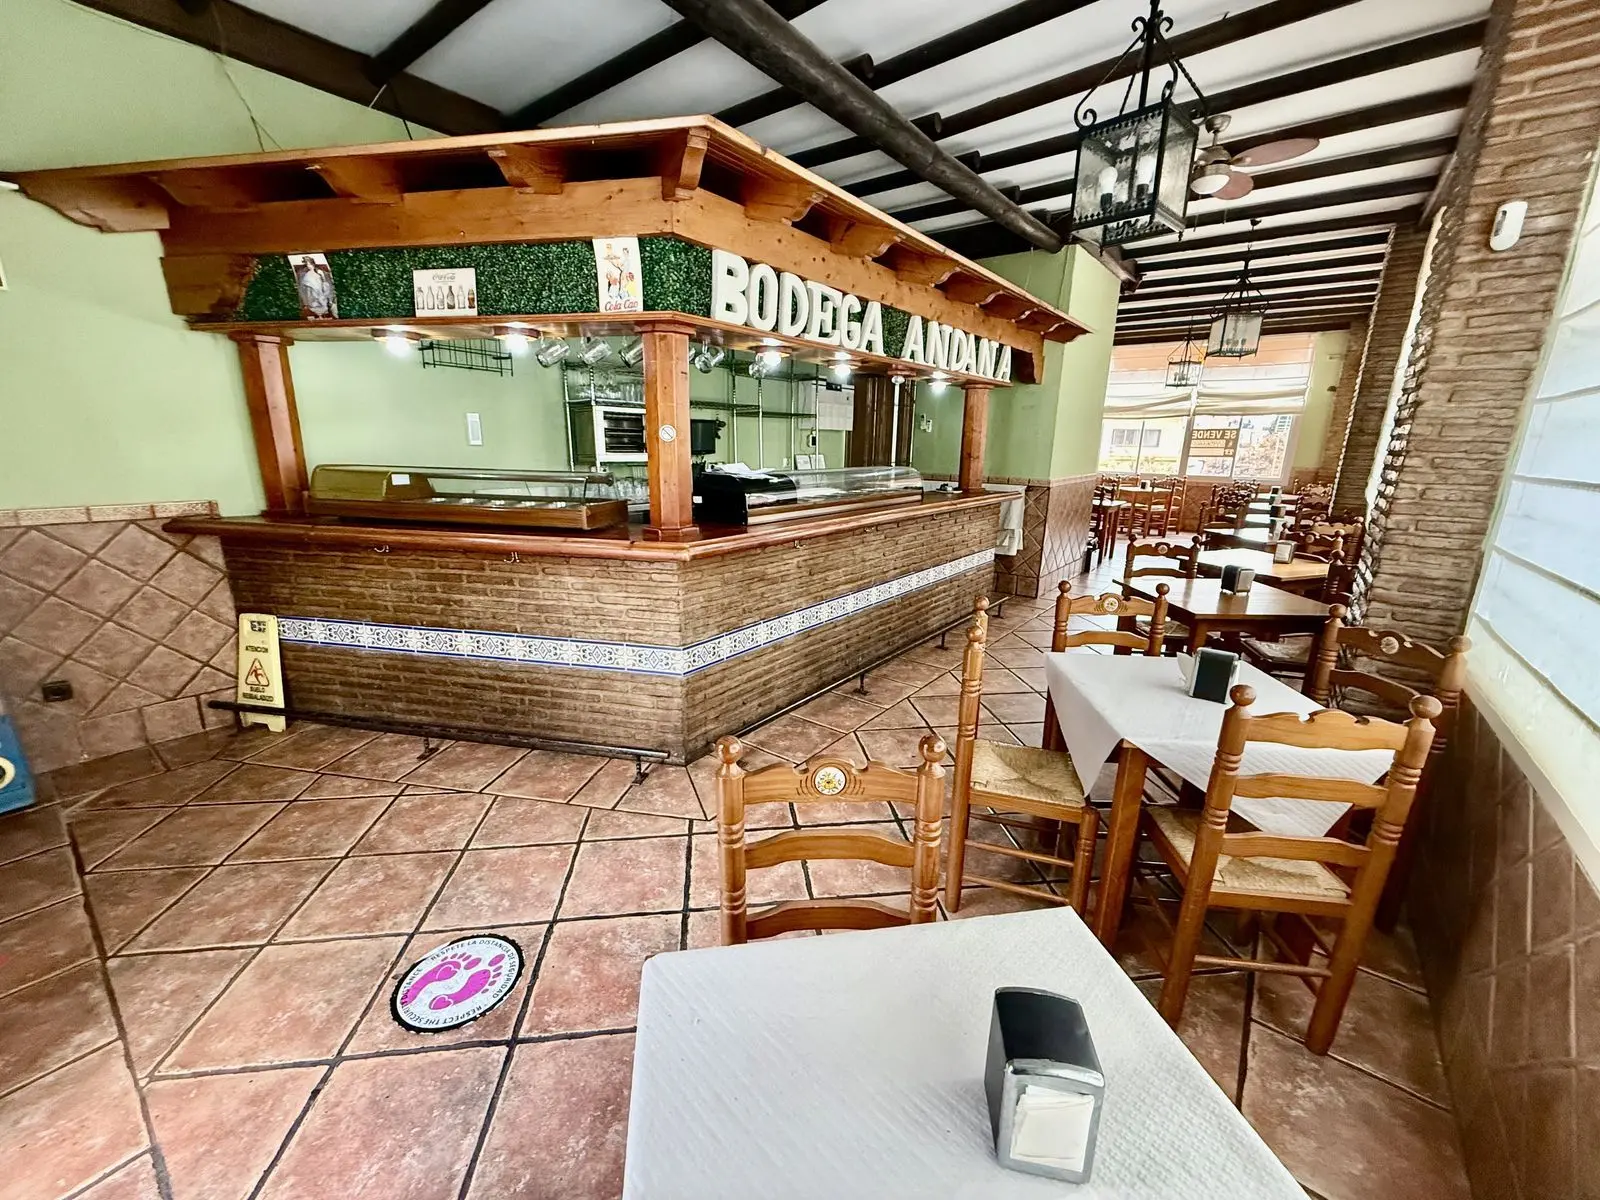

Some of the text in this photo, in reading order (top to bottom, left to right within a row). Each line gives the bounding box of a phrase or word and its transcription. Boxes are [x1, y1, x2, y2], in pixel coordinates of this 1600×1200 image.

[604, 300, 622, 312] Cola
[710, 249, 1012, 383] BODEGA ANDANA
[430, 943, 465, 961] RESPETE
[479, 939, 512, 957] DISTANCIA
[492, 960, 517, 999] SEGURIDAD
[423, 1016, 440, 1026] THE
[441, 1005, 483, 1025] RESPECT
